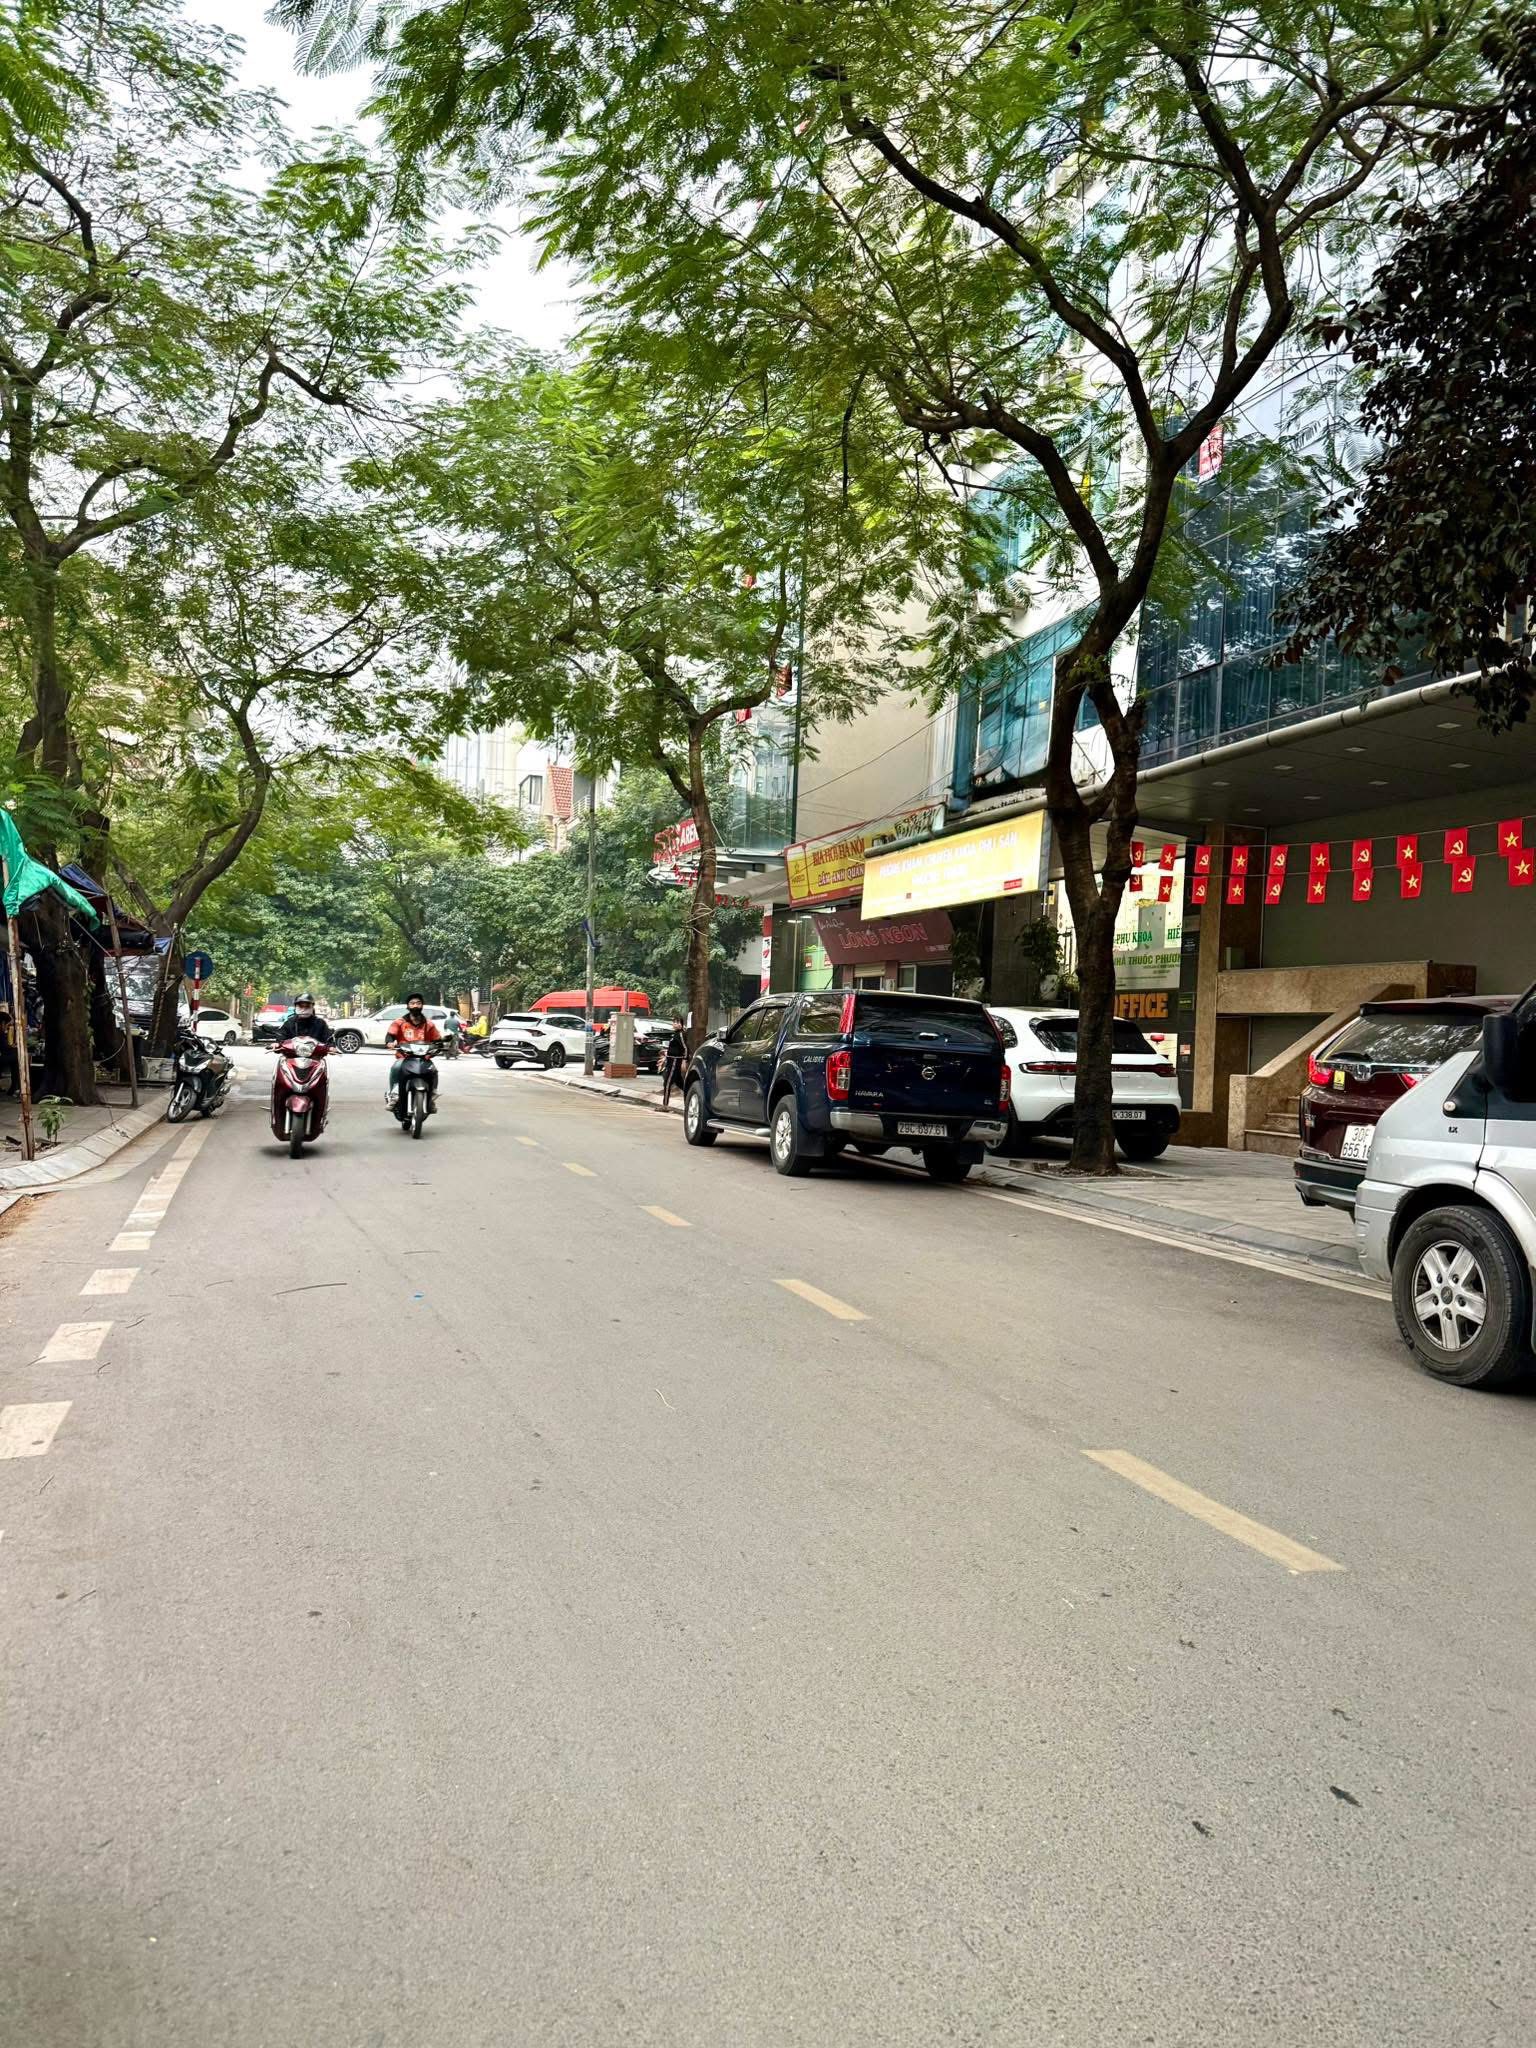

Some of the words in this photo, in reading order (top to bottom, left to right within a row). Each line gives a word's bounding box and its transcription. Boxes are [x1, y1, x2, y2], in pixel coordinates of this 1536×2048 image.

[832, 867, 846, 883] ANH
[1132, 931, 1153, 944] KHOA
[1167, 922, 1183, 940] HIẾ
[803, 1055, 826, 1063] CALIBRE
